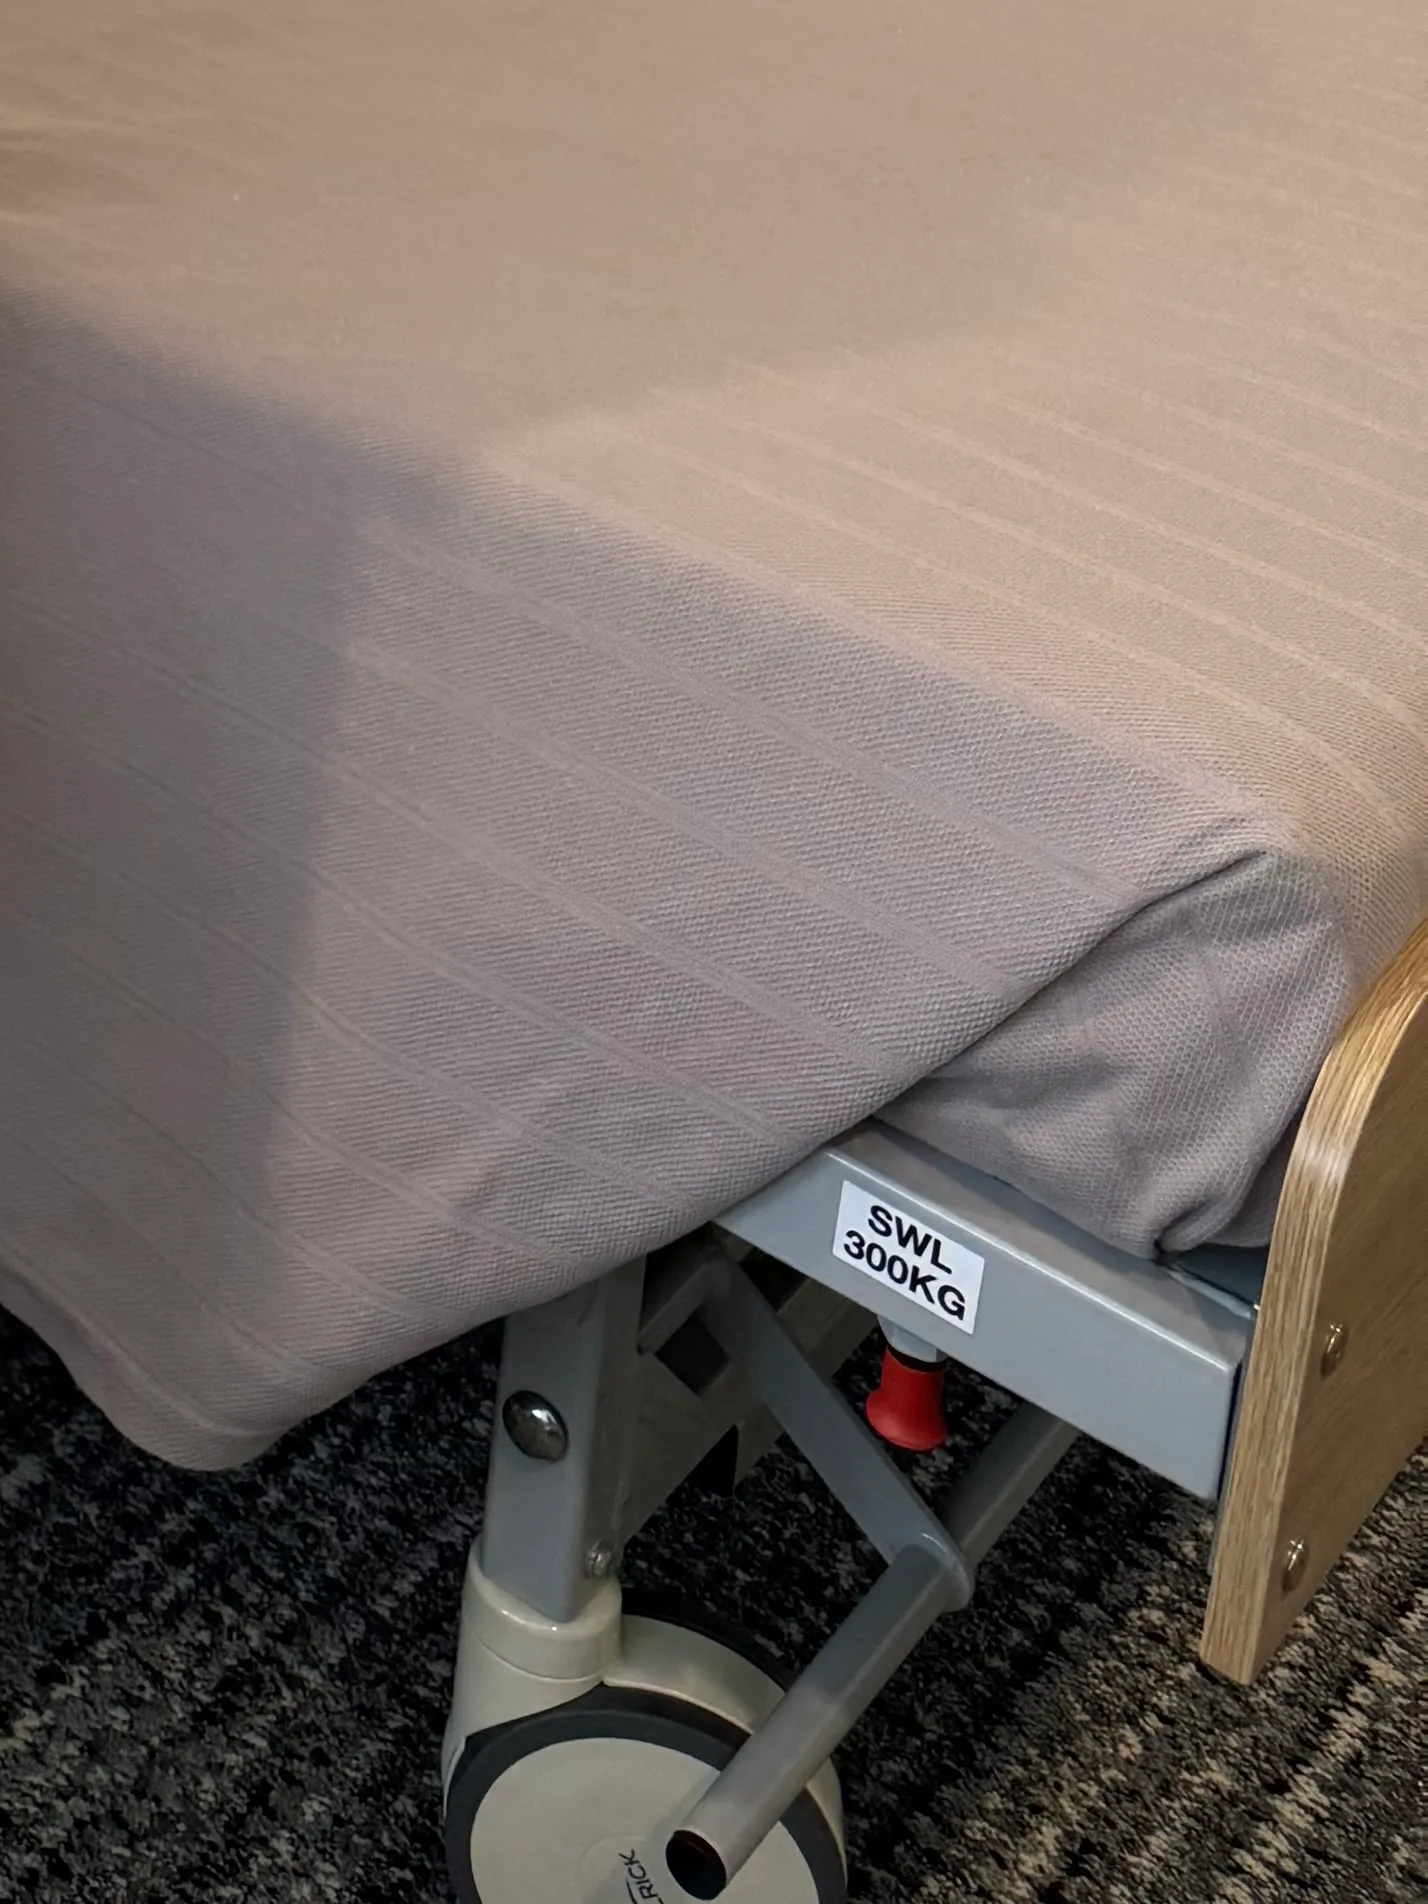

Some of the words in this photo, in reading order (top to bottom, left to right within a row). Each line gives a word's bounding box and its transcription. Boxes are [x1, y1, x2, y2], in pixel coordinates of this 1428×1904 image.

[867, 1204, 953, 1274] SWL
[843, 1229, 966, 1320] 300KG
[618, 1848, 664, 1904] RICK
